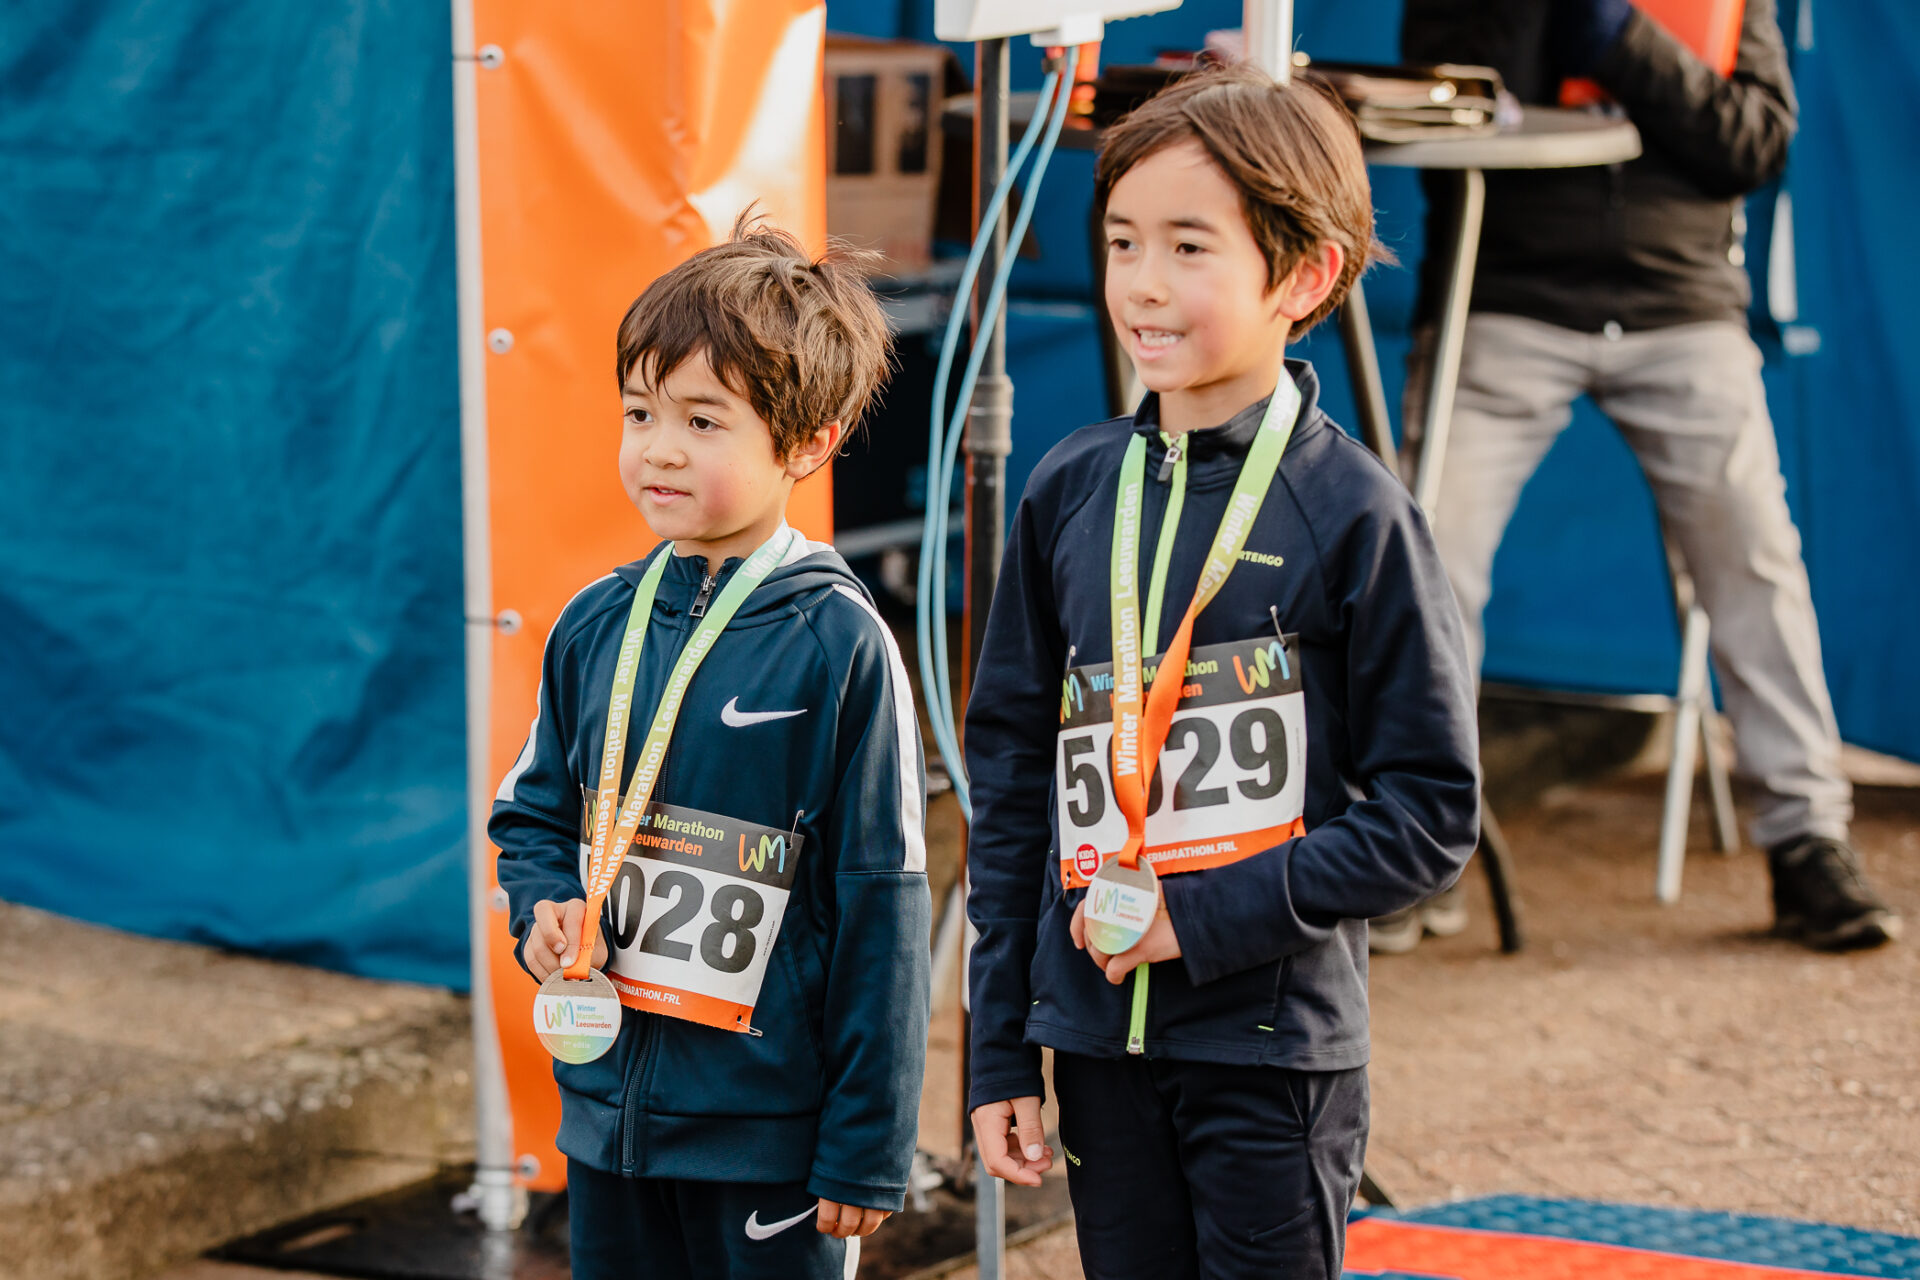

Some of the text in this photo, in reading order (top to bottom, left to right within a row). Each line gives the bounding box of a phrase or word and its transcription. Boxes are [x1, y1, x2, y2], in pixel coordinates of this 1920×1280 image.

[1220, 492, 1258, 555] Winter
[741, 539, 790, 580] Winte
[1238, 551, 1285, 567] RTENGO
[1116, 483, 1138, 776] Winter Marathon Leeuwarden
[617, 627, 643, 684] Winter
[603, 693, 629, 781] Marathon
[594, 836, 628, 897] Winter
[620, 740, 663, 828] Marathon
[653, 628, 716, 733] Leeuwarden
[653, 813, 725, 842] Marathon
[632, 833, 703, 857] euwarden
[1077, 850, 1096, 861] KIDS
[1147, 841, 1238, 862] ERMARATHON.FRL
[1079, 860, 1096, 870] RUN
[590, 856, 765, 974] 028
[576, 1004, 597, 1012] Winter
[576, 1020, 612, 1029] Leeuwarden
